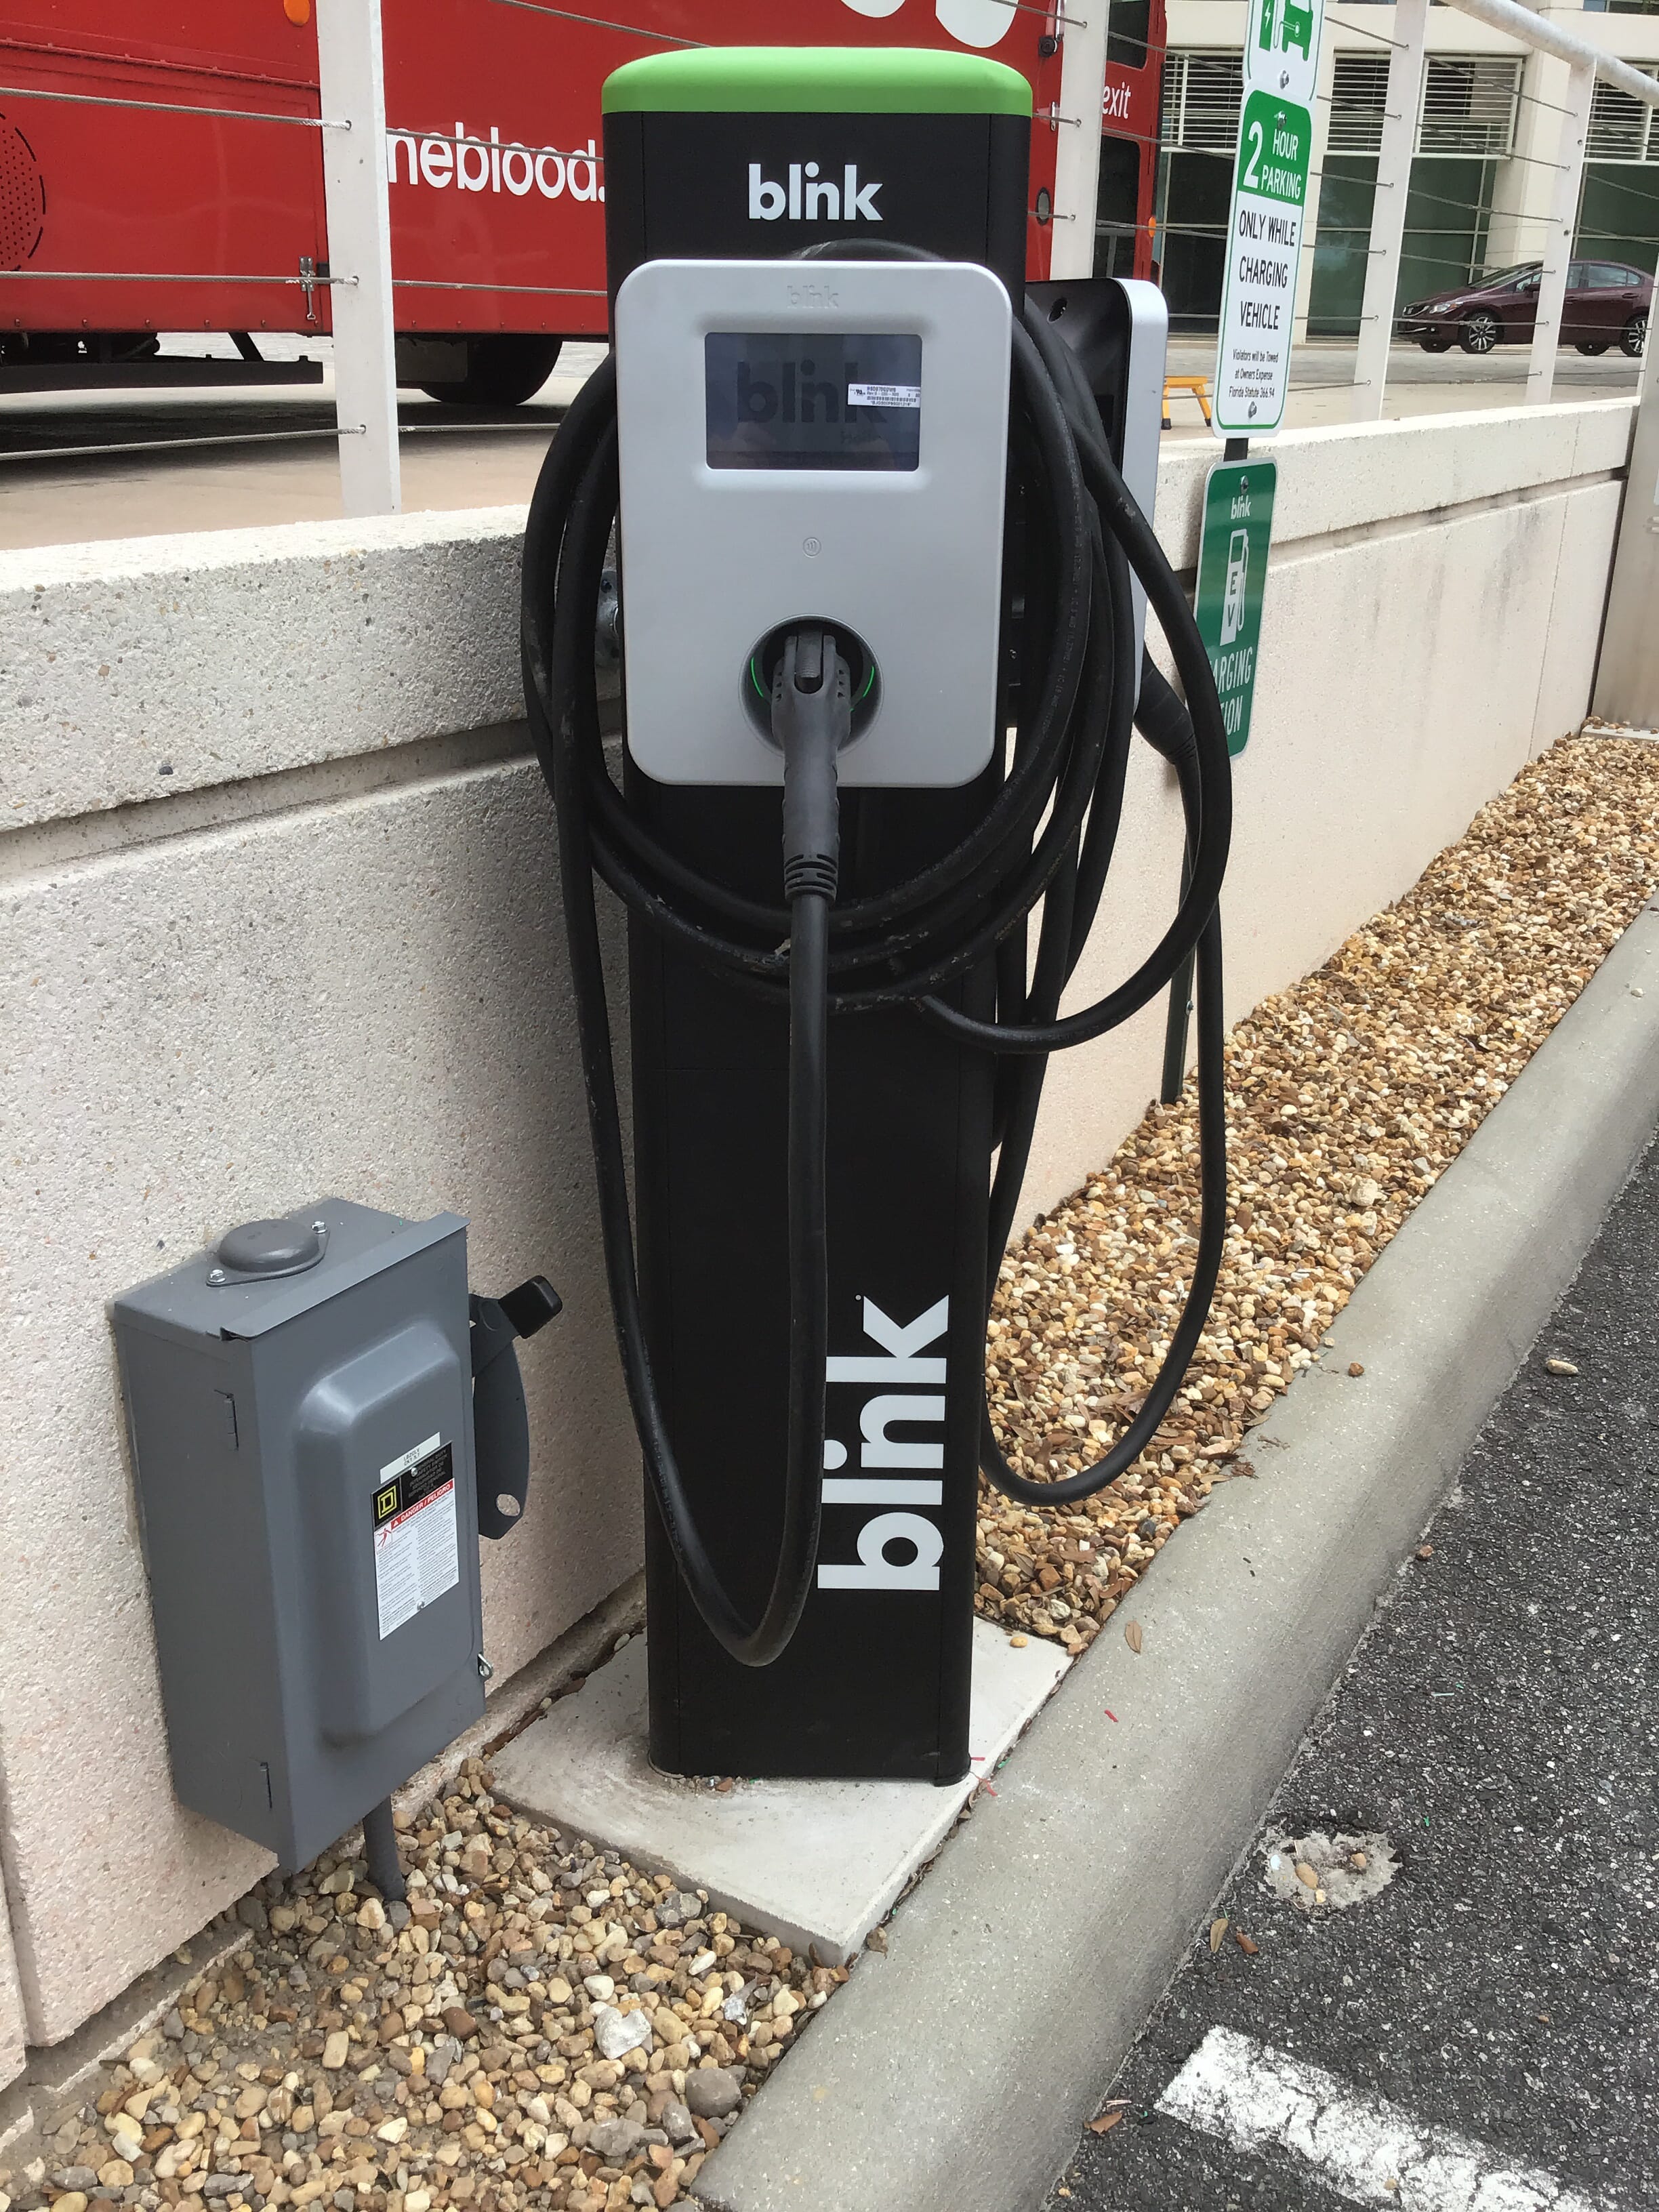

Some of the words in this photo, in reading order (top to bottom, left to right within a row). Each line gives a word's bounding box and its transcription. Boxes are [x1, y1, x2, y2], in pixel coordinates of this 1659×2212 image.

[1103, 81, 1131, 119] exit
[1243, 121, 1263, 189] 2
[1272, 129, 1298, 161] HOUR
[748, 162, 884, 221] blink
[1261, 165, 1302, 200] PARKING
[1239, 209, 1266, 241] ONLY
[1268, 216, 1296, 247] WHILE
[1239, 255, 1288, 289] CHARGING
[787, 285, 839, 309] blink
[1240, 300, 1280, 330] VEHICLE
[1233, 348, 1251, 361] Violators
[1260, 351, 1265, 363] be
[1266, 351, 1279, 363] Towed
[1229, 386, 1244, 398] Florida
[1244, 386, 1259, 398] Statute
[1235, 368, 1240, 380] at
[1240, 367, 1255, 380] Owners
[1256, 368, 1273, 384] Expense
[1230, 495, 1252, 520] blink
[1210, 646, 1253, 695] ARGING
[817, 1295, 949, 1591] blink
[401, 1502, 424, 1521] DANGER
[427, 1483, 450, 1504] PELIGRO
